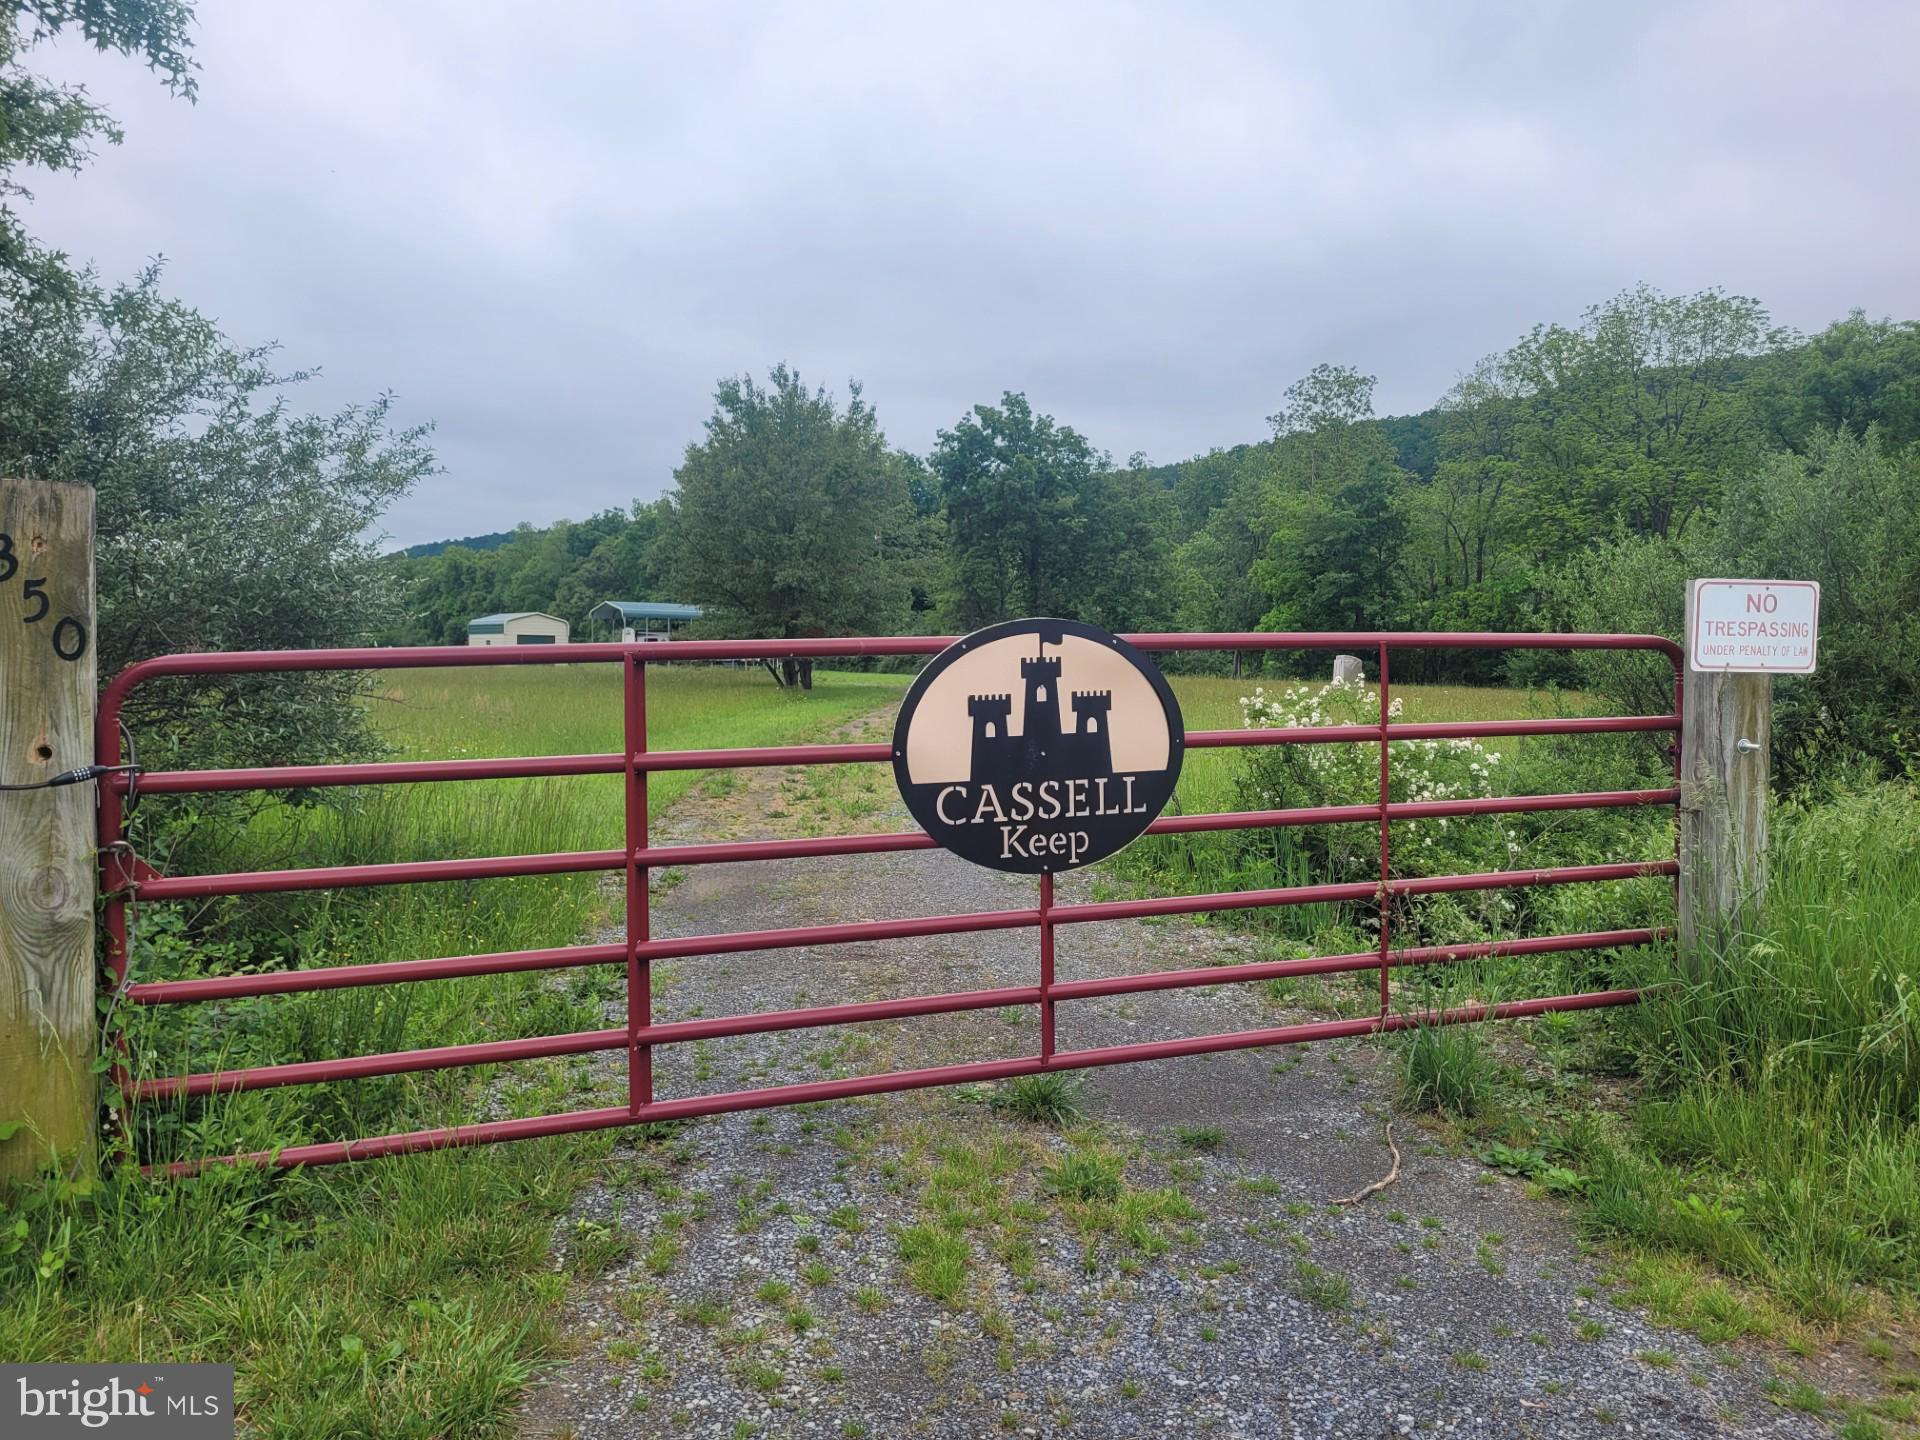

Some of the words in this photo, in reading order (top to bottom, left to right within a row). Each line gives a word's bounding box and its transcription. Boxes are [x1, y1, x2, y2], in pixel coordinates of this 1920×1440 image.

[1746, 593, 1778, 613] NO
[1705, 621, 1809, 638] TRESPASSING
[1703, 645, 1735, 656] UNDER
[1739, 645, 1778, 657] PENALTY
[1781, 646, 1792, 657] OF
[1793, 646, 1808, 657] LAW
[936, 776, 1147, 825] CASSELL
[1000, 825, 1089, 864] Keep
